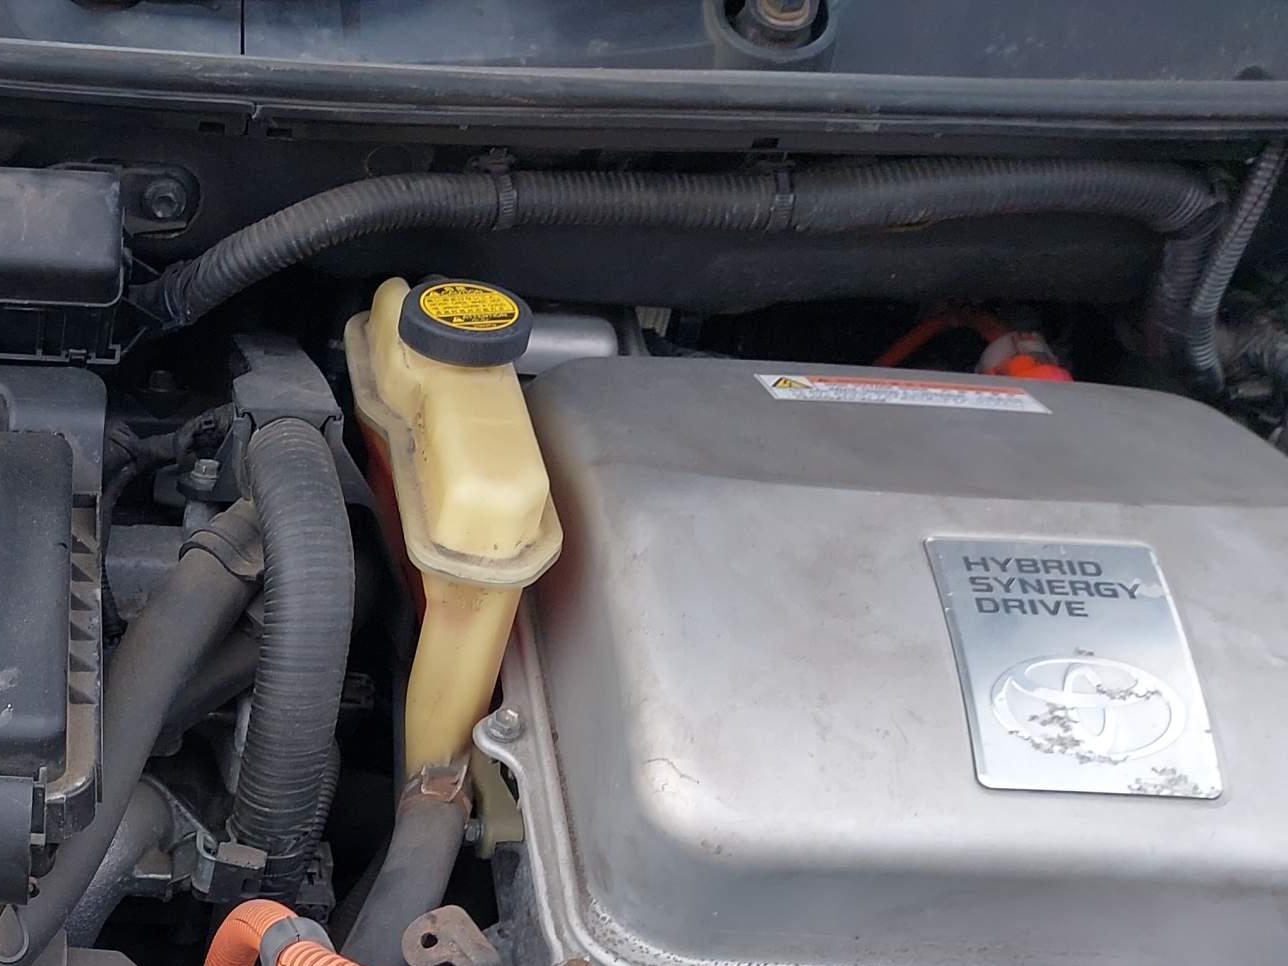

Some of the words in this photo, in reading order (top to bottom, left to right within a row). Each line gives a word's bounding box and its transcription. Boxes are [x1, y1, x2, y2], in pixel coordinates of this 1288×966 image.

[962, 556, 1103, 577] HYBRID
[968, 577, 1141, 599] SYNERGY
[975, 597, 1089, 618] DRIVE
